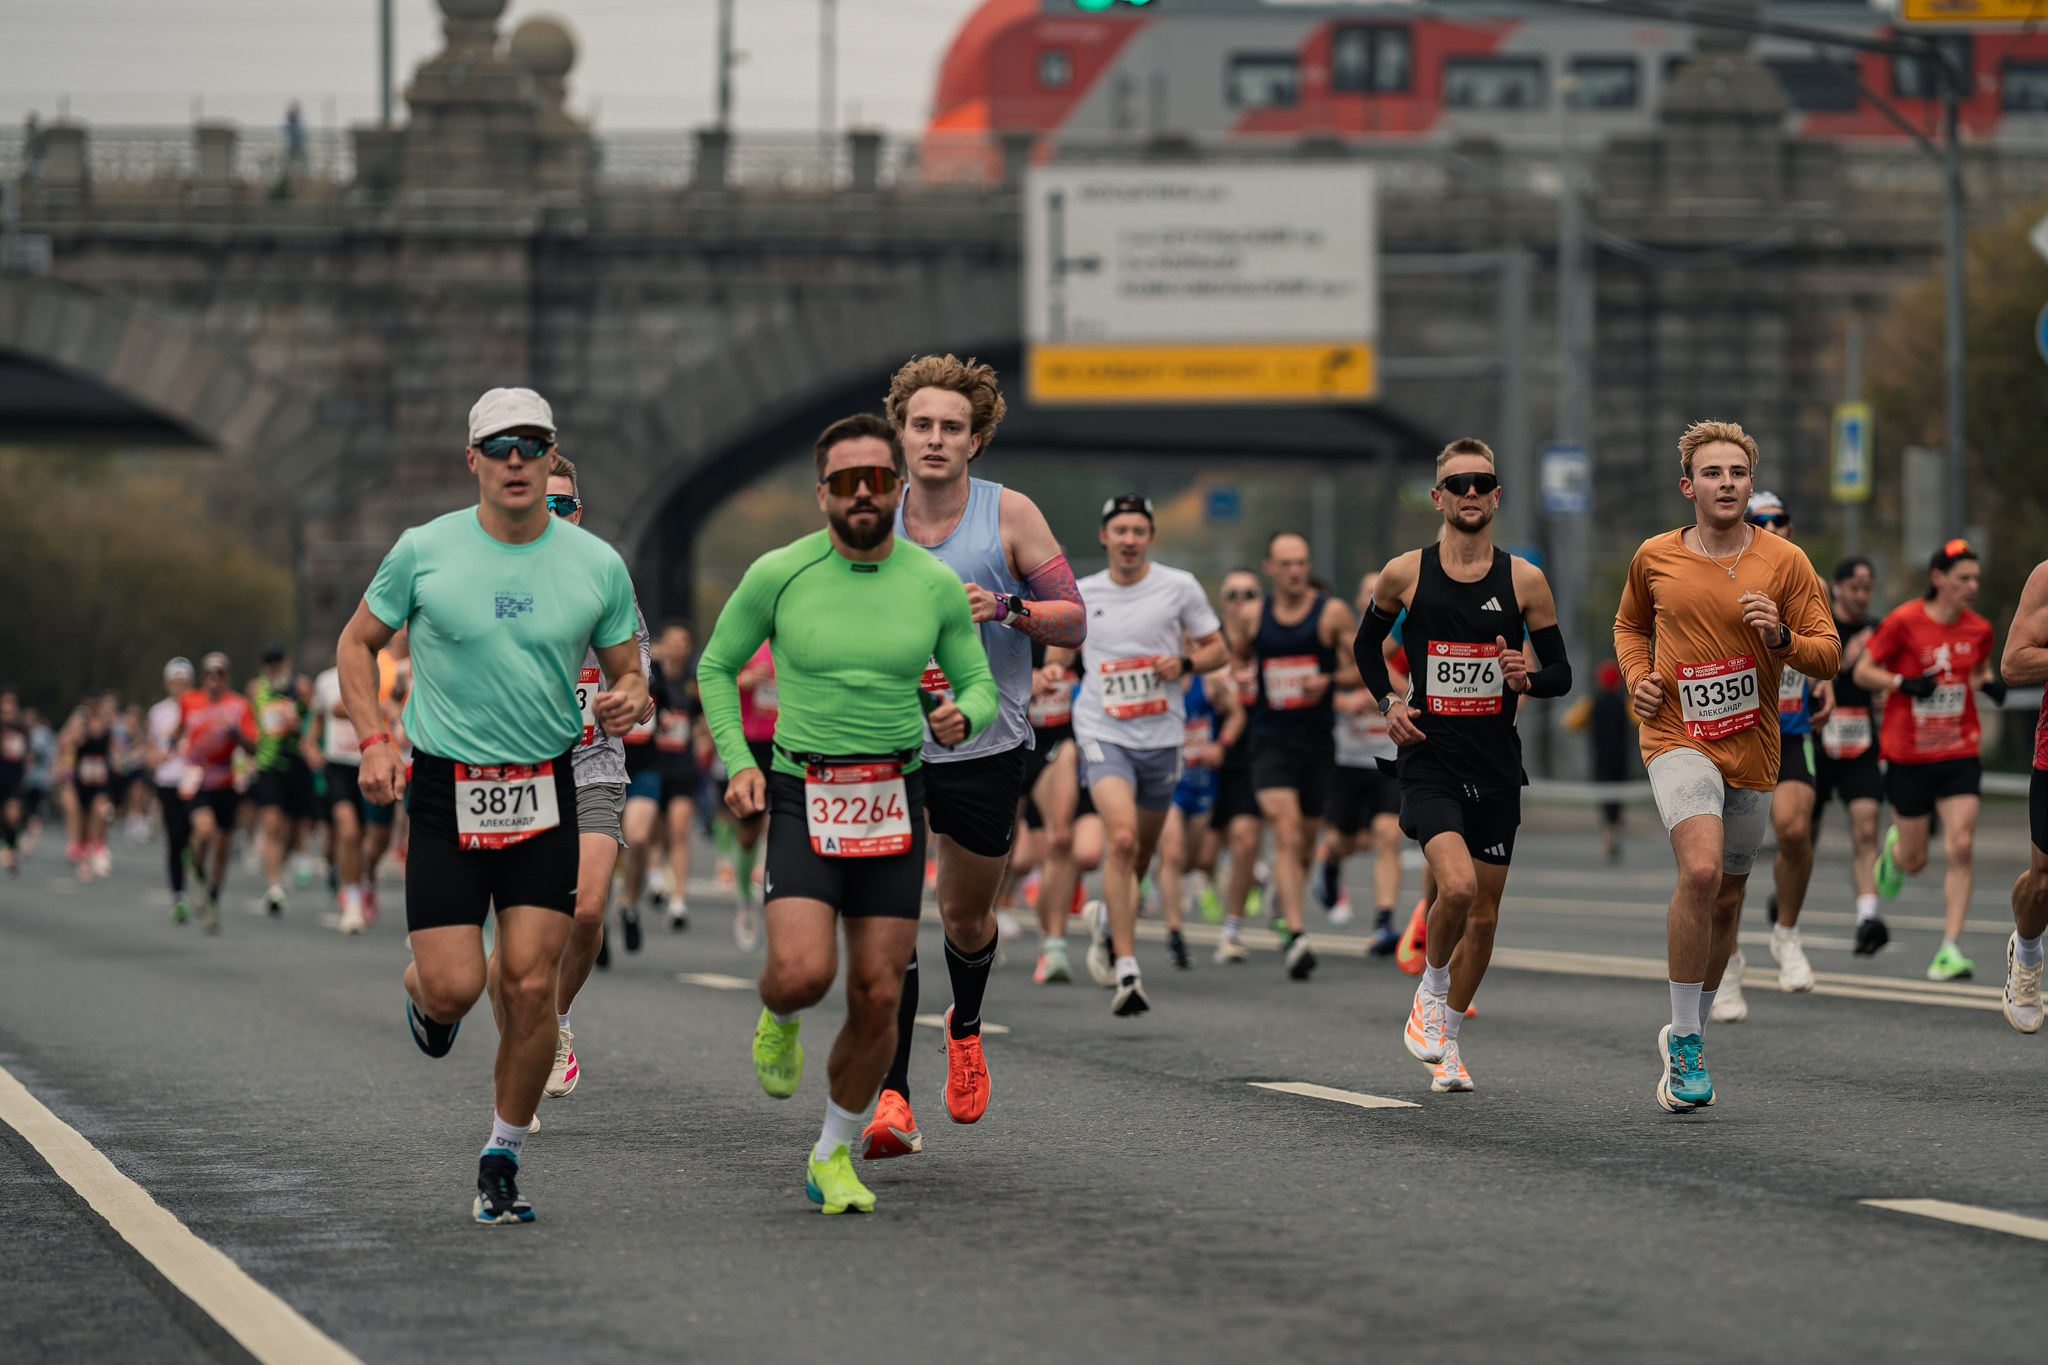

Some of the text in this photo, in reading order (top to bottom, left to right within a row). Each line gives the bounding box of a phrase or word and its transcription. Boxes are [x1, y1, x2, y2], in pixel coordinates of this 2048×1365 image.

[1437, 661, 1495, 684] 8576
[1453, 686, 1478, 694] АРТЕМ
[1682, 674, 1755, 707] 13350
[1433, 698, 1443, 712] B
[1698, 702, 1742, 717] АЛЕКСАНДР
[1693, 723, 1704, 737] A
[470, 784, 539, 815] 3871
[812, 793, 904, 824] 32264
[479, 816, 536, 828] АЛЕКСАНДР
[468, 835, 481, 850] A
[825, 837, 837, 851] A
